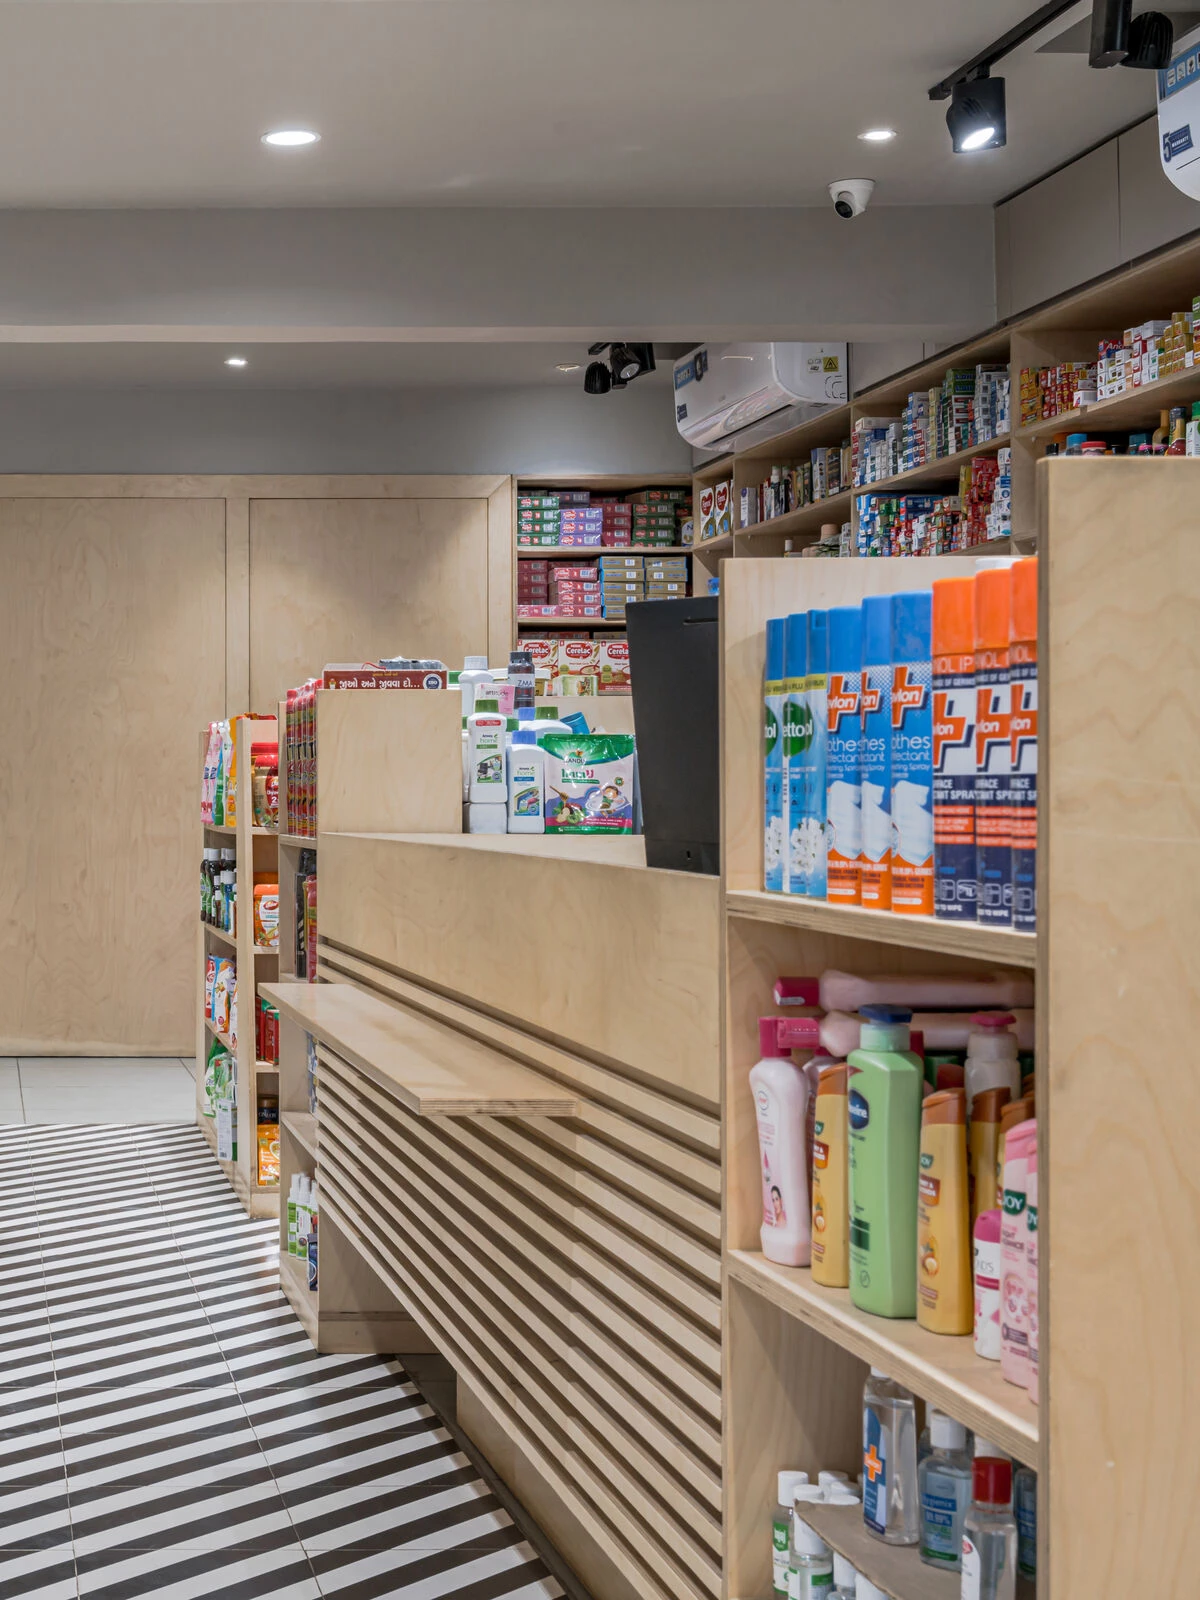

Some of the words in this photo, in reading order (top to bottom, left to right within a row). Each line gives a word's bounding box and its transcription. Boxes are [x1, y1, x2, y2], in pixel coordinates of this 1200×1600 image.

[566, 647, 591, 655] Cerelac
[608, 648, 629, 656] Cerela
[361, 677, 377, 689] અને
[891, 733, 931, 750] othes
